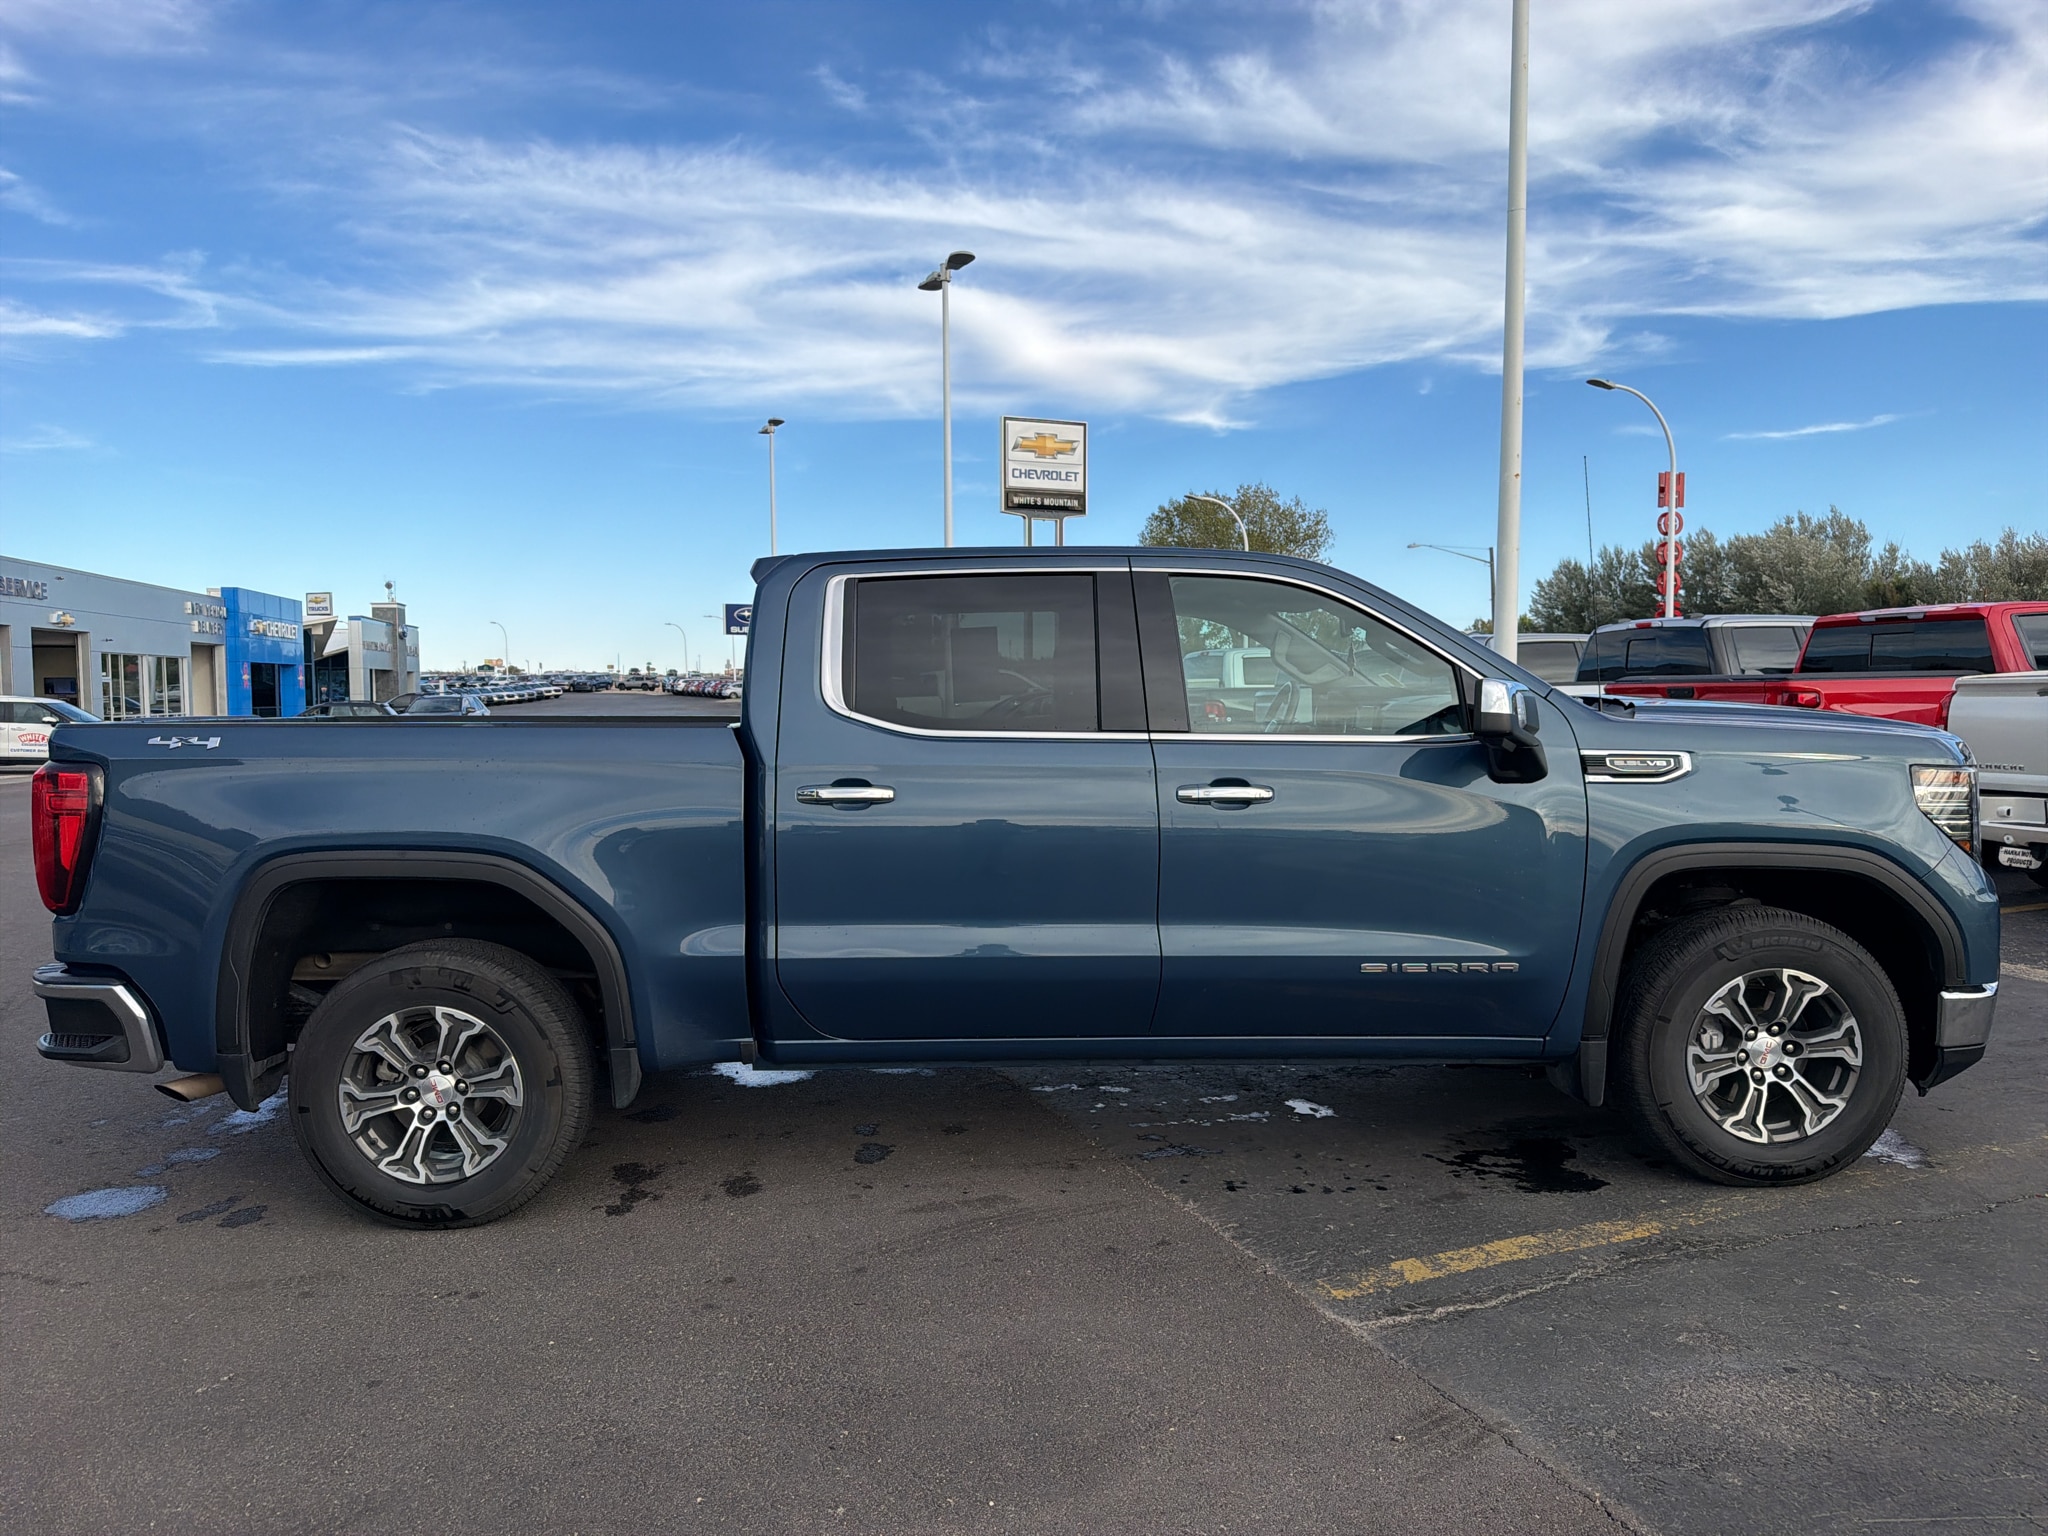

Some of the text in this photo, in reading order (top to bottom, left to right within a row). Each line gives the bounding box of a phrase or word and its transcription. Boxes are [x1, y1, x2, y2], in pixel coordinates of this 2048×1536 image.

[1012, 468, 1079, 482] CHEVROLET
[1013, 496, 1079, 507] WHITE'S MOUNTAIN
[0, 576, 48, 600] SERVICE
[266, 620, 298, 639] CHEVROLET
[1360, 962, 1520, 974] SIERRA
[1759, 1040, 1773, 1065] GMC
[429, 1078, 445, 1104] GMC
